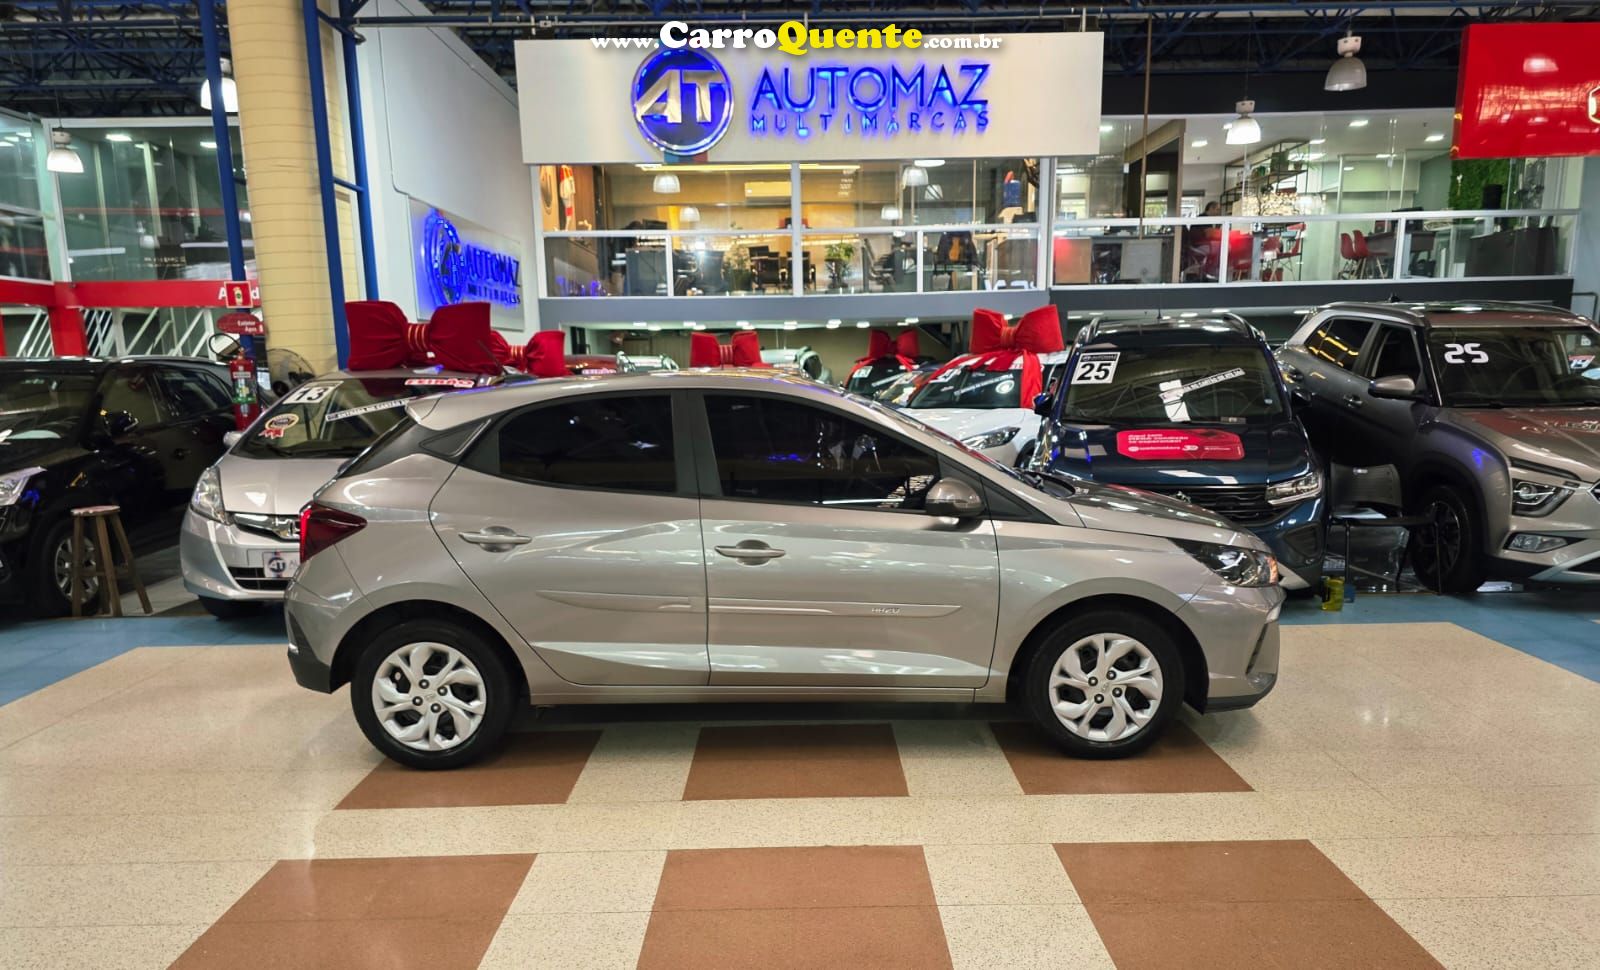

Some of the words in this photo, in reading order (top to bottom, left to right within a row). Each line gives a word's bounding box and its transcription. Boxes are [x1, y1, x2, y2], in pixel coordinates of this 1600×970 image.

[635, 69, 725, 123] AT
[752, 64, 990, 112] AUTOMAZ
[752, 111, 989, 134] MULTIMARCAS
[1443, 342, 1489, 364] 25
[1076, 362, 1112, 381] 25
[295, 387, 329, 401] 13
